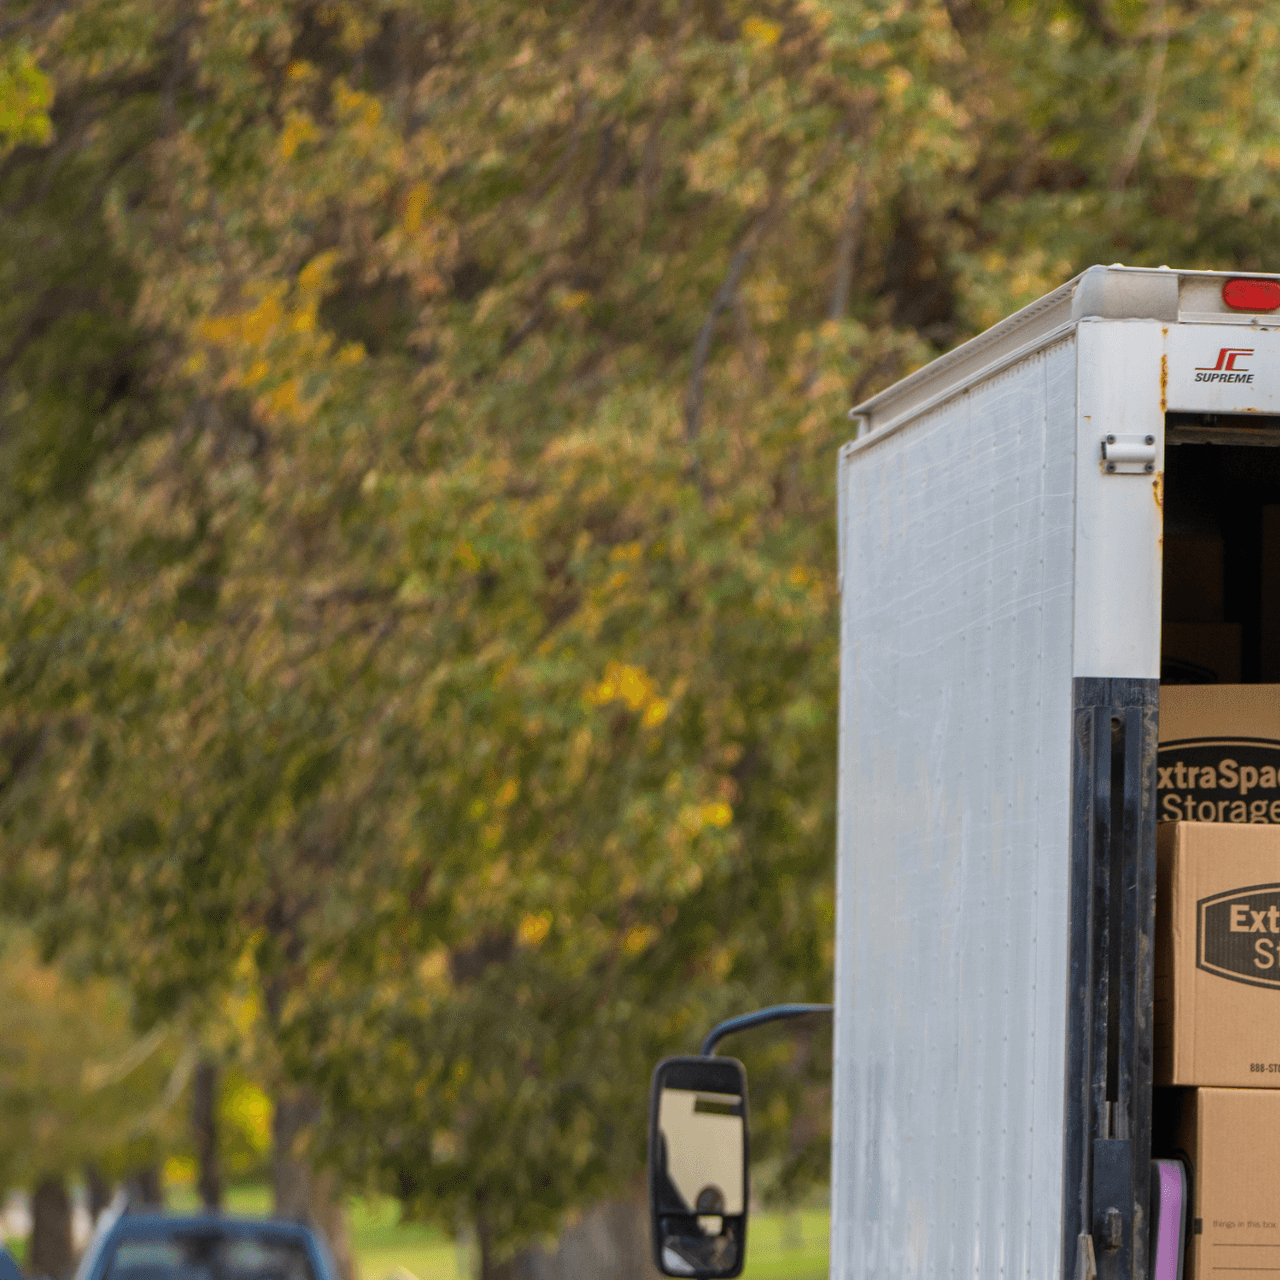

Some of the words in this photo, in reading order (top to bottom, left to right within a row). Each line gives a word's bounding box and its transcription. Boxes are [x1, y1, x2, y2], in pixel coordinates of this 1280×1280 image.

[1194, 372, 1255, 384] SUPREME
[1213, 1219, 1236, 1230] things
[1237, 1219, 1245, 1229] in
[1247, 1219, 1261, 1229] this
